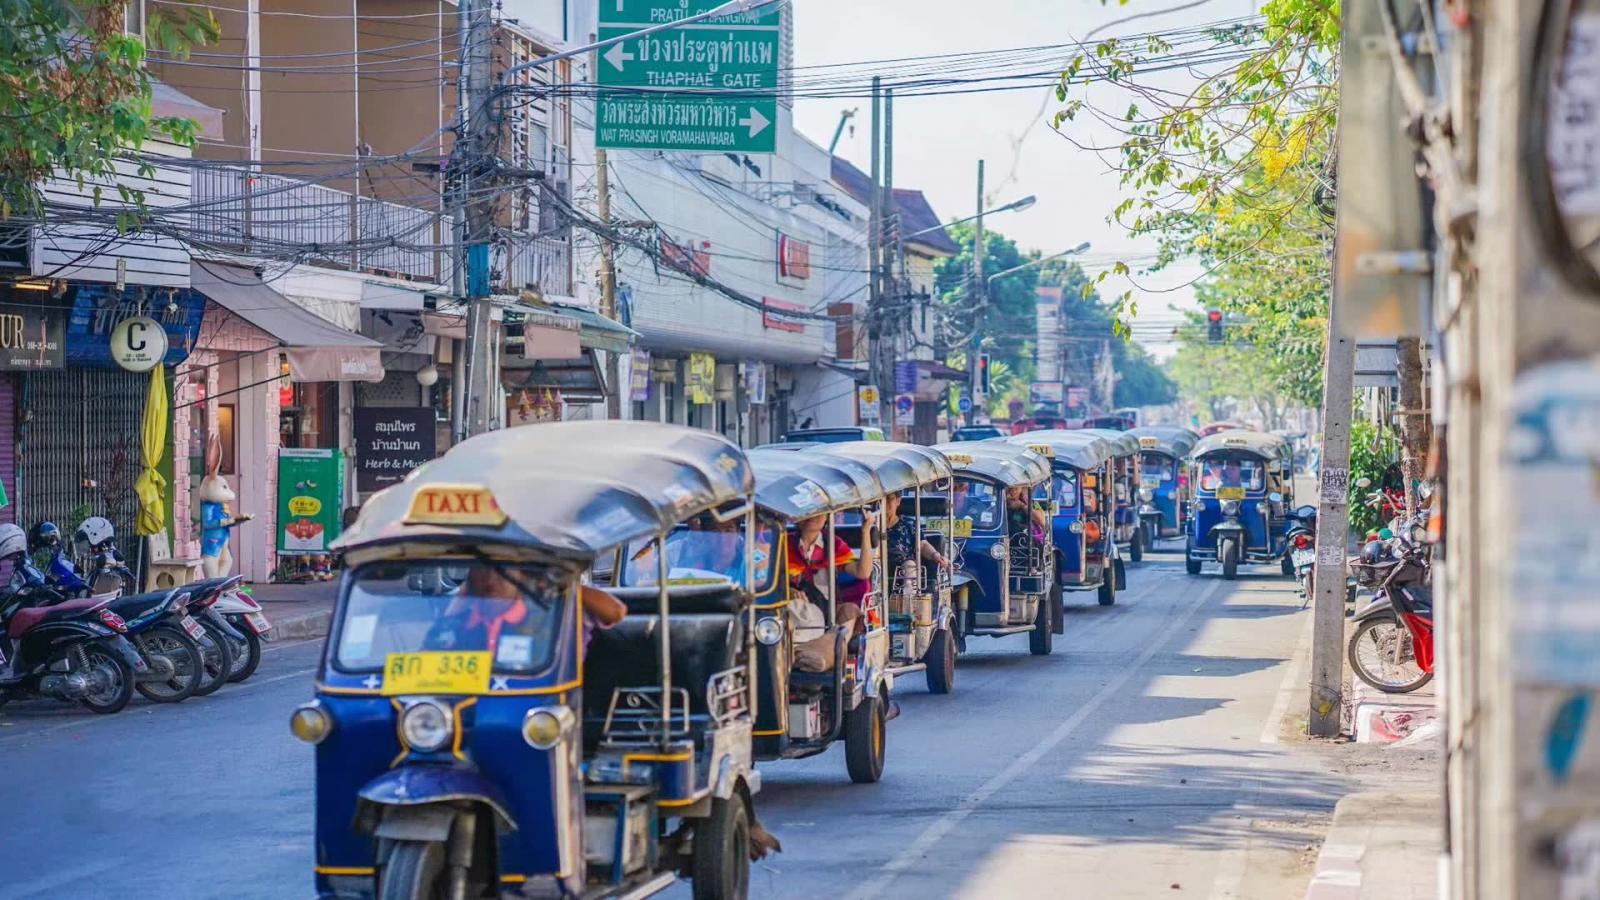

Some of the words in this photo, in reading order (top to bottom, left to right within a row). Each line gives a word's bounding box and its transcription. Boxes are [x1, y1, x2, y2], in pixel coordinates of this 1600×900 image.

[646, 71, 714, 87] THAPHAE
[722, 73, 762, 88] GATE
[600, 129, 616, 142] WAT
[619, 129, 659, 144] PRASINGH
[661, 130, 736, 145] VORAMAHAVIHARA
[127, 321, 147, 351] C
[375, 420, 417, 435] สมุนไพร
[365, 458, 390, 469] Herb
[391, 459, 401, 469] &
[424, 492, 482, 514] TAXI
[438, 655, 479, 675] 336
